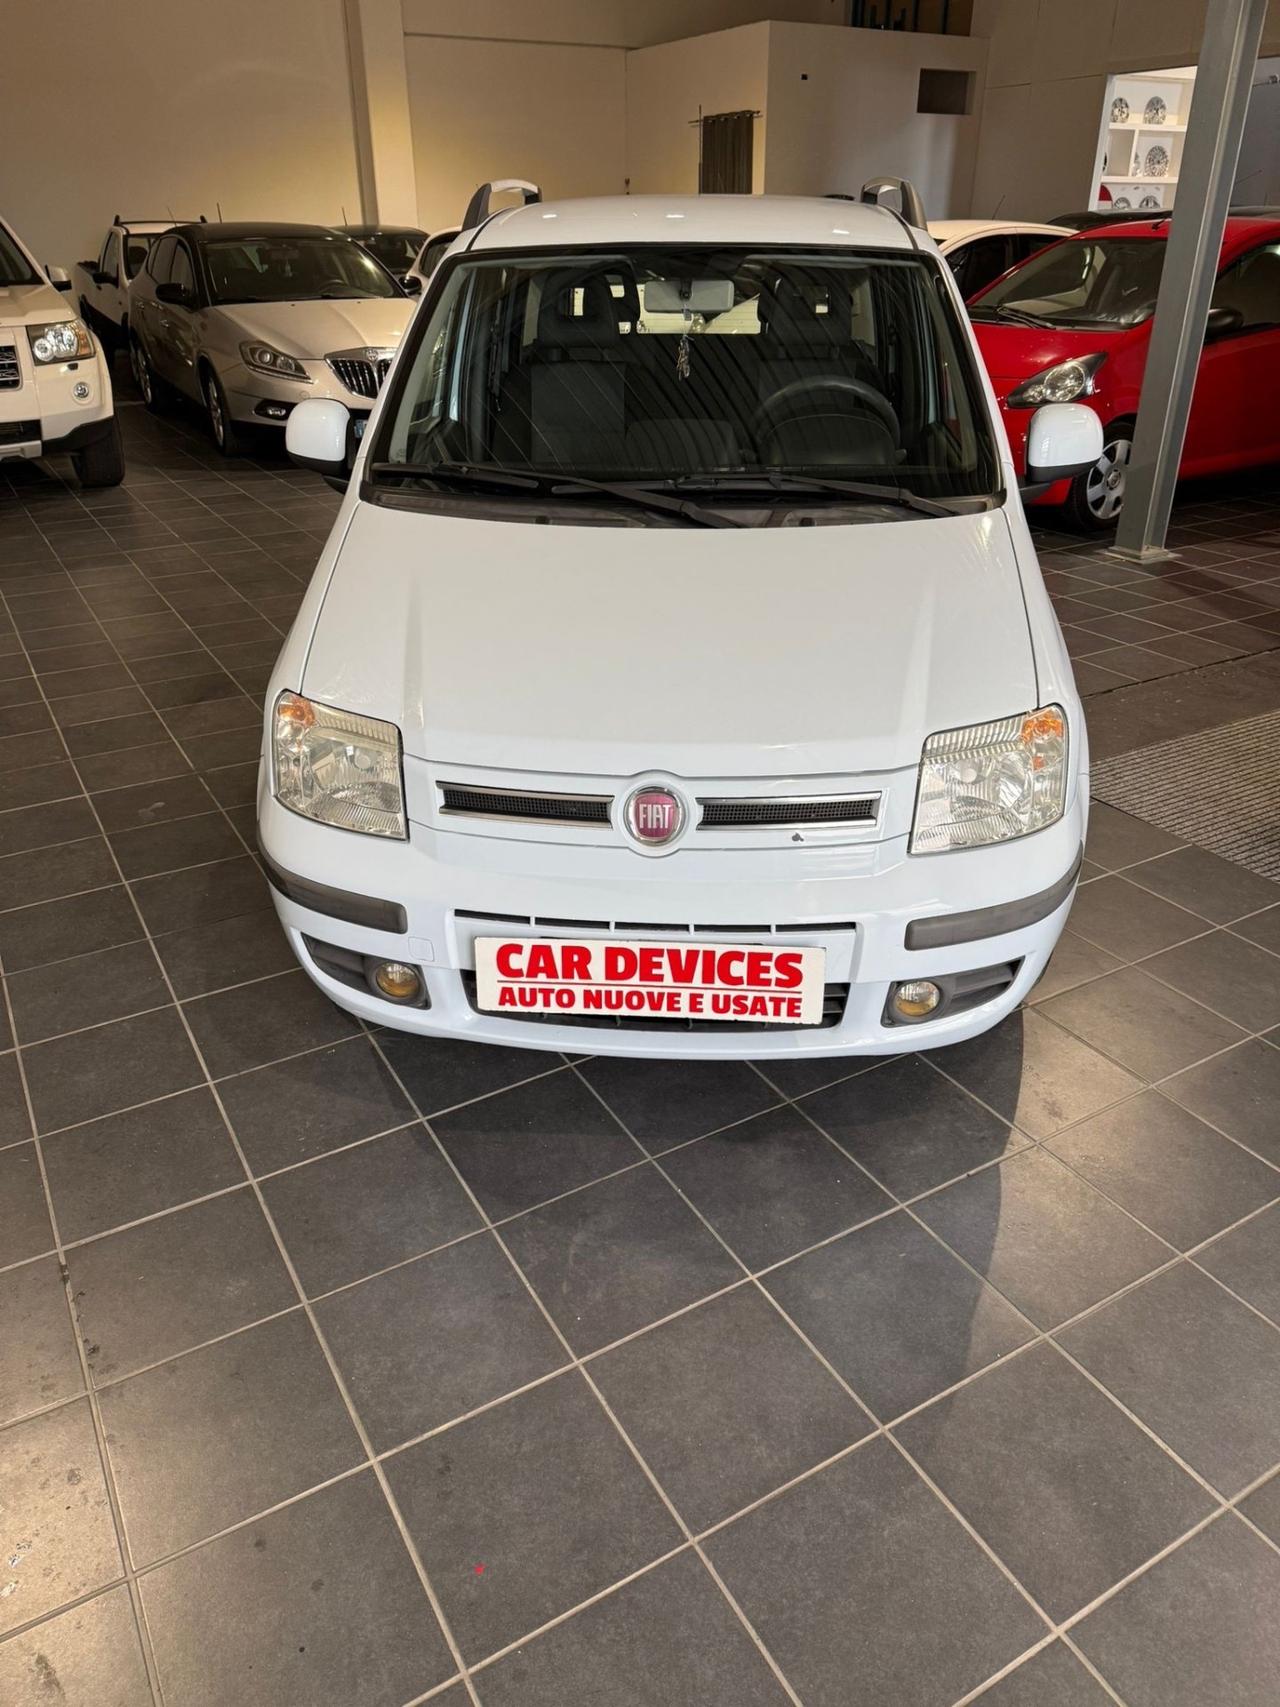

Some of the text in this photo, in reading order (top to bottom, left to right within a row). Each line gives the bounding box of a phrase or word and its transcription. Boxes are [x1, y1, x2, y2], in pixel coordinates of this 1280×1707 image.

[639, 803, 672, 829] FIAT
[496, 943, 804, 988] CAR DEVICES
[498, 986, 801, 1018] AUTO NUOVE E USATE
